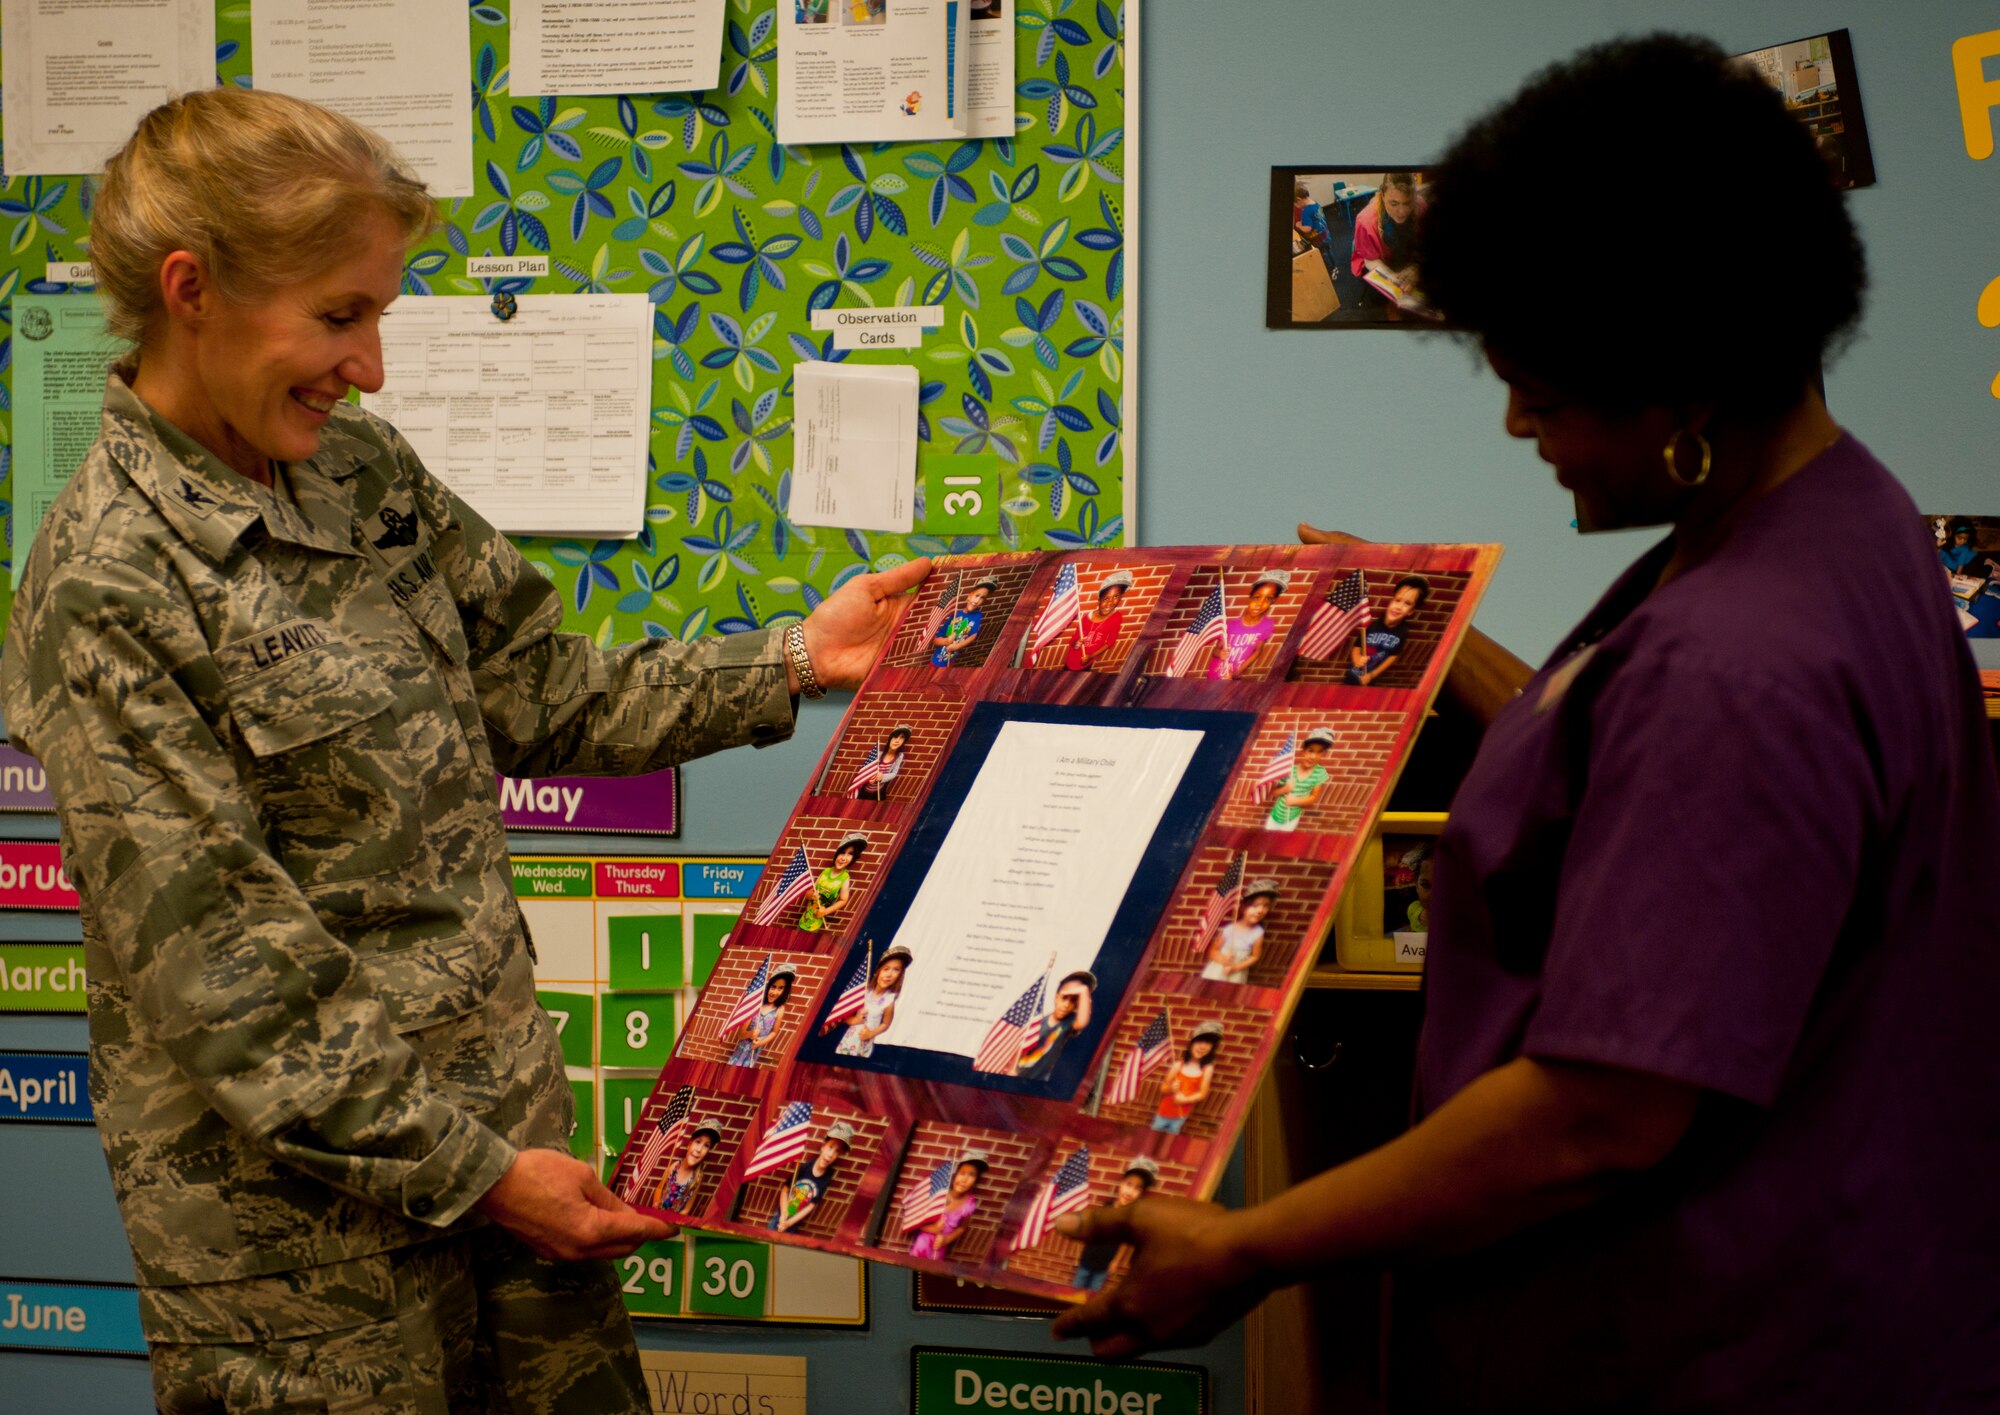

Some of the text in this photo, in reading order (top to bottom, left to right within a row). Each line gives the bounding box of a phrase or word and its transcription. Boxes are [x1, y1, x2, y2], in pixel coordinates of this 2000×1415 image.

[470, 260, 546, 273] Lesson Plan
[837, 311, 917, 325] Observation
[860, 331, 896, 345] Cards
[943, 476, 983, 517] 31
[1234, 632, 1262, 647] LOVE
[1366, 632, 1401, 649] SUPER
[500, 777, 584, 824] May
[511, 864, 745, 882] Wednesday Thursday Friday
[532, 879, 734, 895] Wed. Thurs. Fri.
[625, 1009, 650, 1050] 8
[0, 1067, 77, 1113] April
[622, 1255, 756, 1299] 29 30
[2, 1293, 87, 1333] June
[655, 1370, 775, 1415] Words
[954, 1368, 1163, 1415] December
